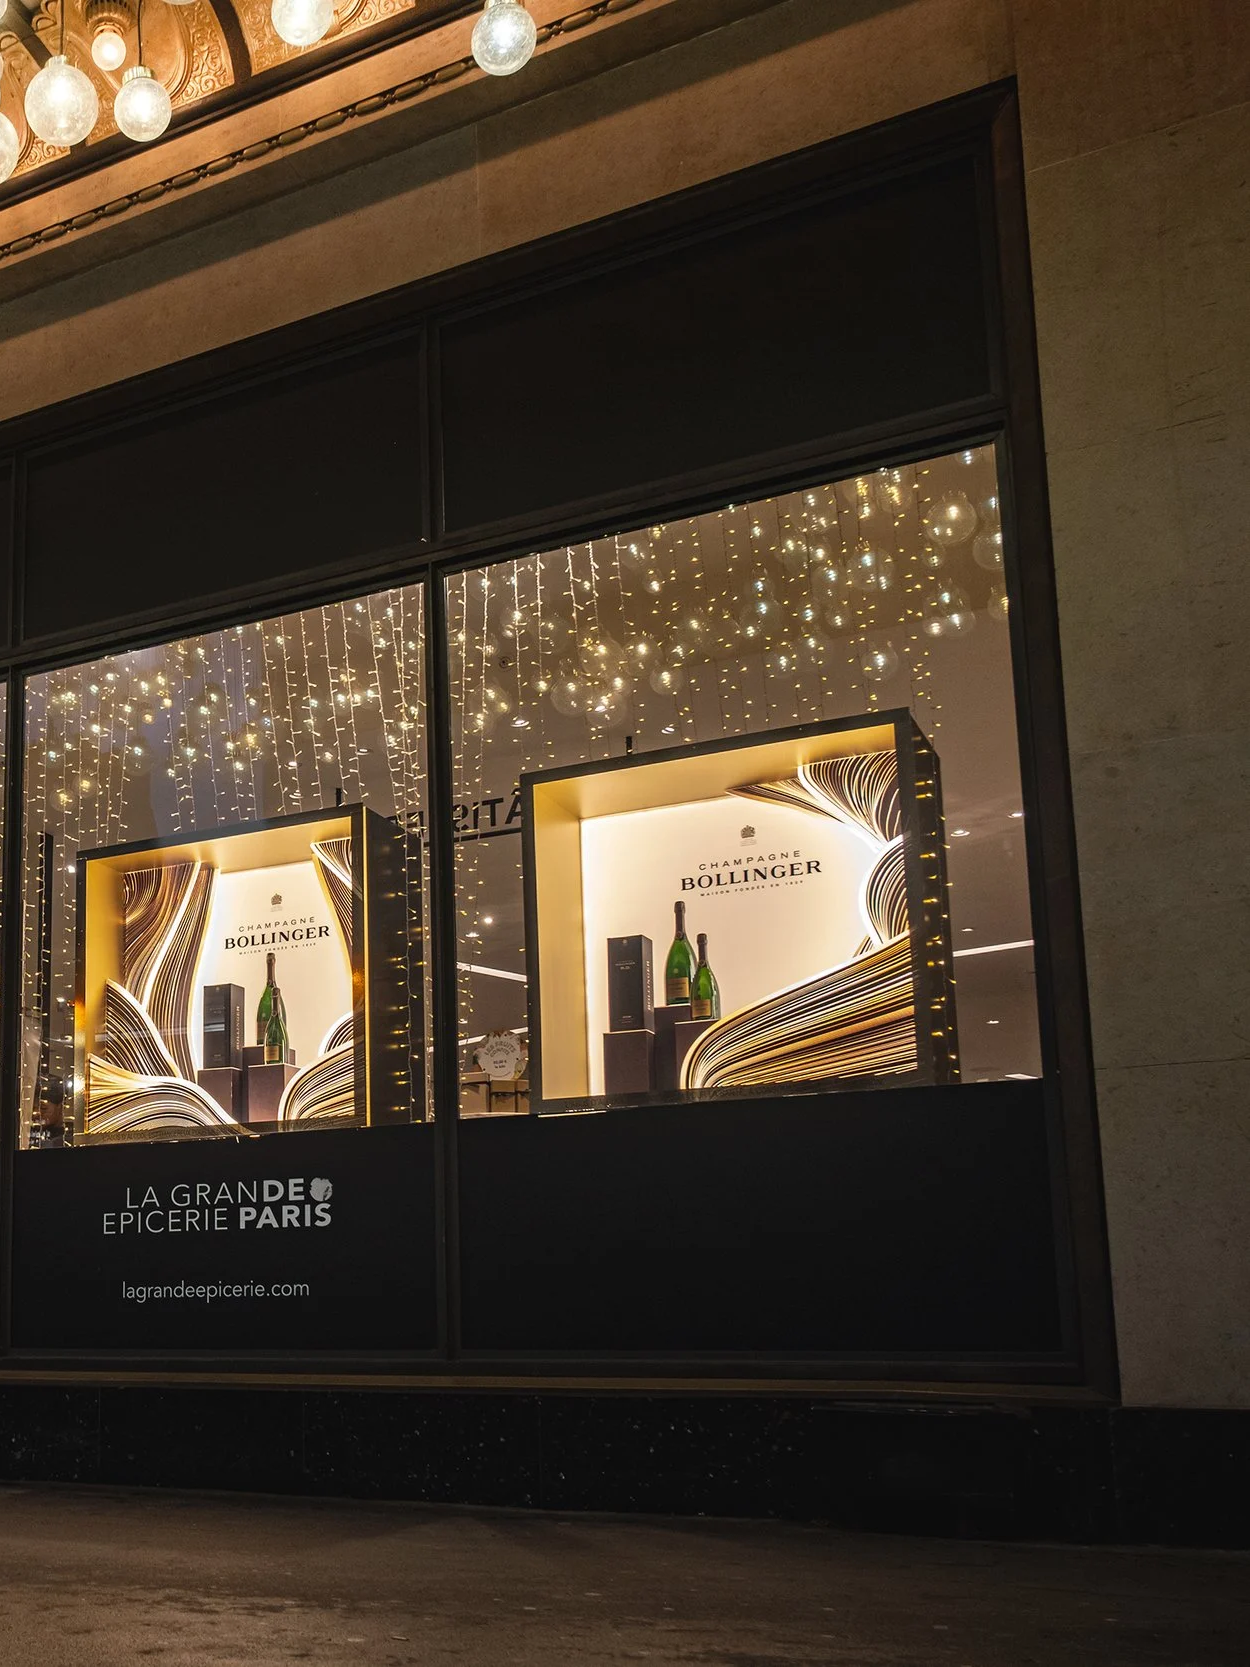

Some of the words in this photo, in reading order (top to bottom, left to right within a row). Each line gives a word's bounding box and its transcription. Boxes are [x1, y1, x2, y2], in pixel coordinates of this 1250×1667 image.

[698, 850, 801, 871] CHAMPAGNE
[680, 860, 822, 891] BOLLINGER
[238, 916, 315, 932] CHAMPAGNE
[225, 925, 330, 949] BOLLINGER
[126, 1186, 160, 1209] LA
[170, 1178, 305, 1207] GRANDE
[103, 1208, 228, 1235] EPICERIE
[239, 1203, 332, 1230] PARIS
[122, 1279, 310, 1304] lagrandeepicerie.com
